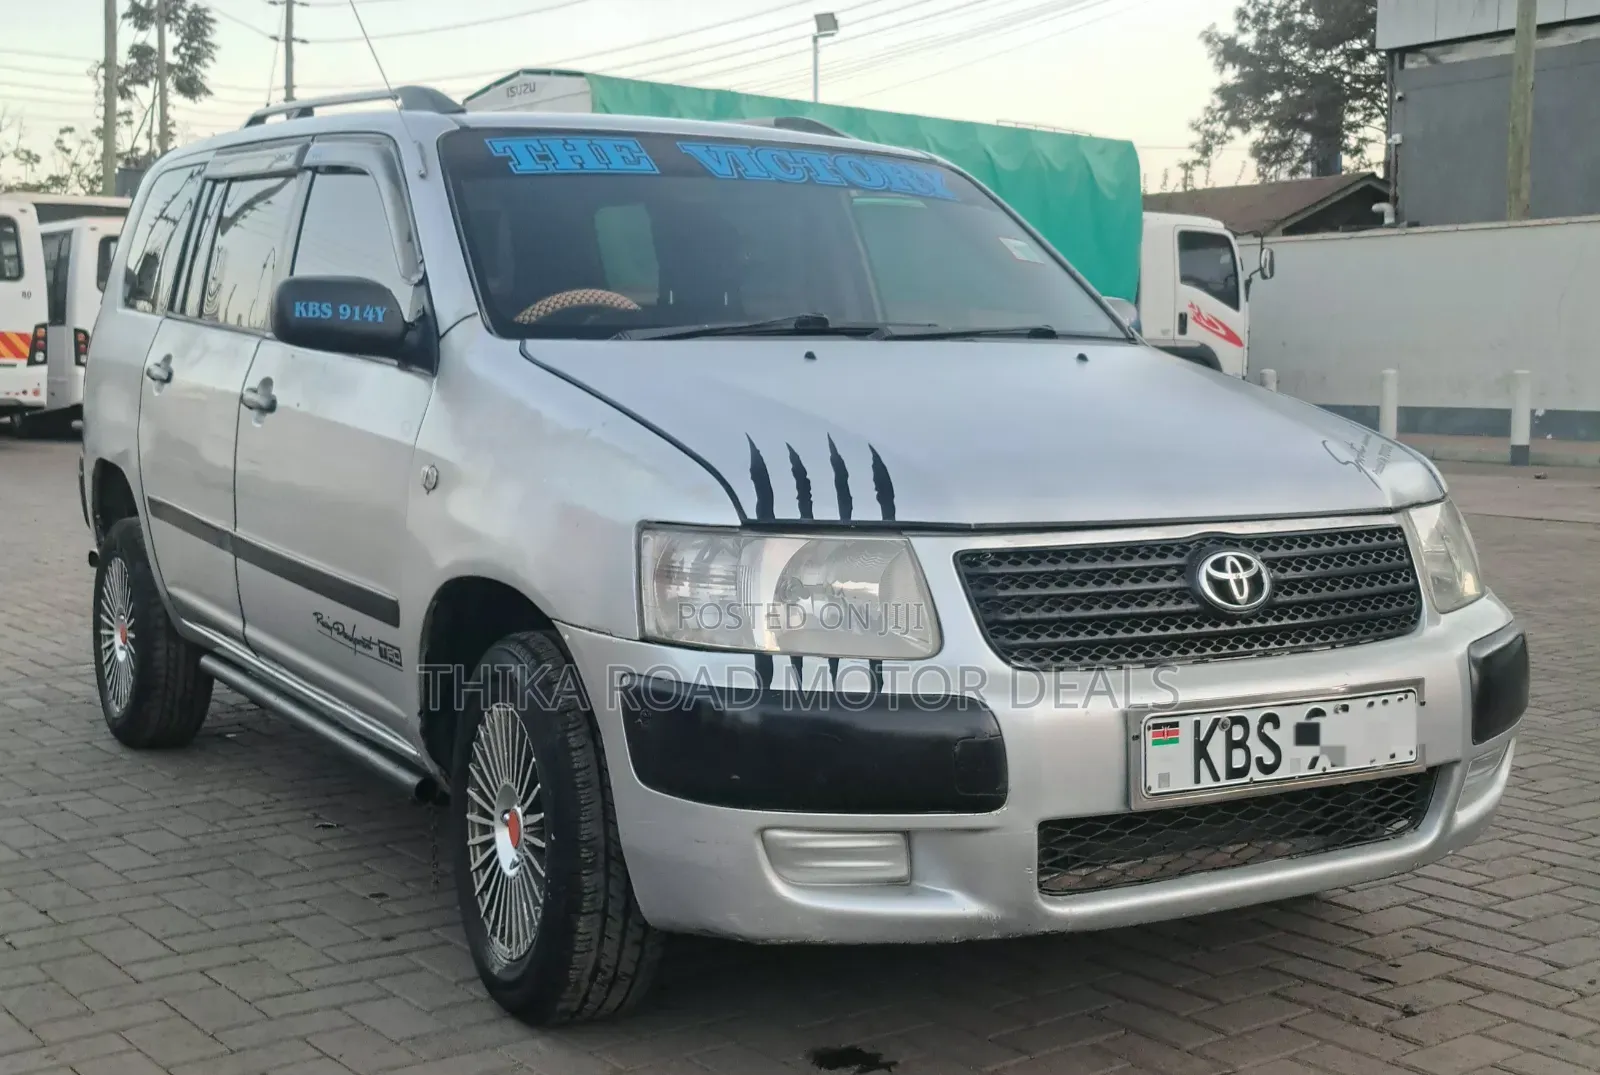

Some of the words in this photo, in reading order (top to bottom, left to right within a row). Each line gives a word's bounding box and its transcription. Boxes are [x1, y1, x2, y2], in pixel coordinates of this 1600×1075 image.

[506, 82, 536, 98] ISUZU
[484, 136, 660, 175] THE
[676, 141, 958, 201] VICTORY
[294, 301, 333, 319] KBS
[338, 303, 387, 323] 914Y
[1193, 710, 1282, 785] KBS
